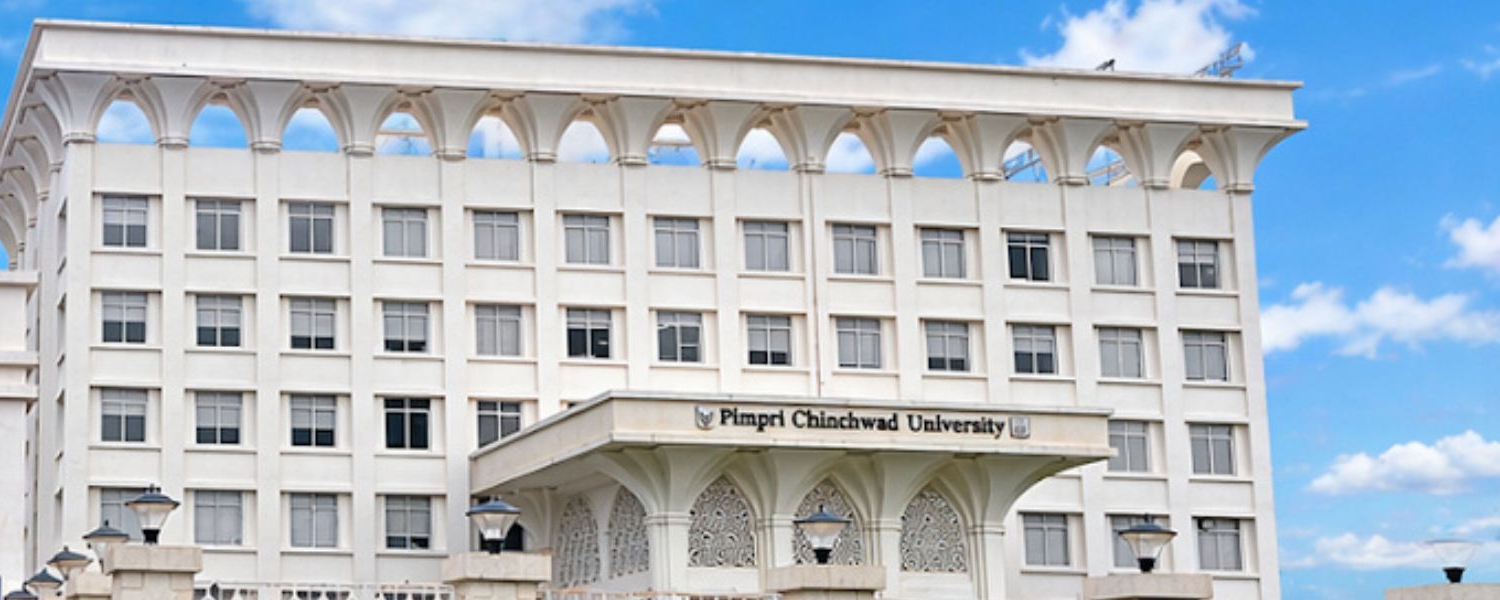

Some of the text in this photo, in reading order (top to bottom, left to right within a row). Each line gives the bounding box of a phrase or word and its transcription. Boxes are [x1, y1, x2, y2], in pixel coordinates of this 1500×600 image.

[720, 408, 1005, 438] Pimpri Chinchwad University
